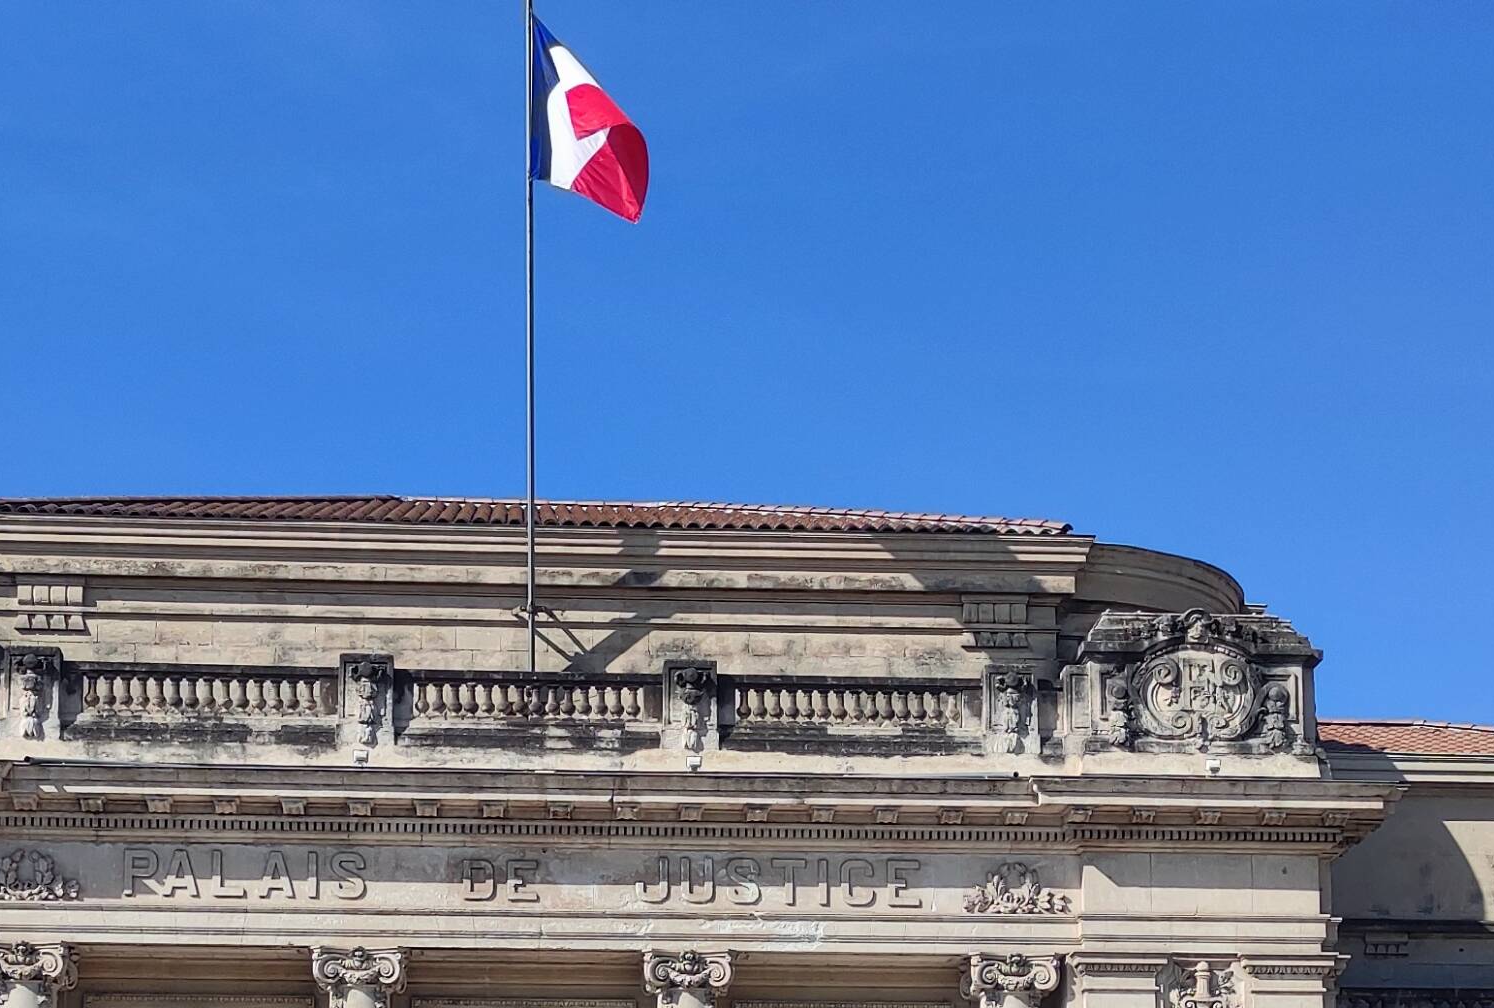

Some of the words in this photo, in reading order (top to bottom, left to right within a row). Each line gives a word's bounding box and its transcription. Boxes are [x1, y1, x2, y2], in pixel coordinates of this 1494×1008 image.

[122, 848, 368, 899] PALAIS
[462, 858, 540, 902] DE
[635, 856, 923, 907] JUSTICE
